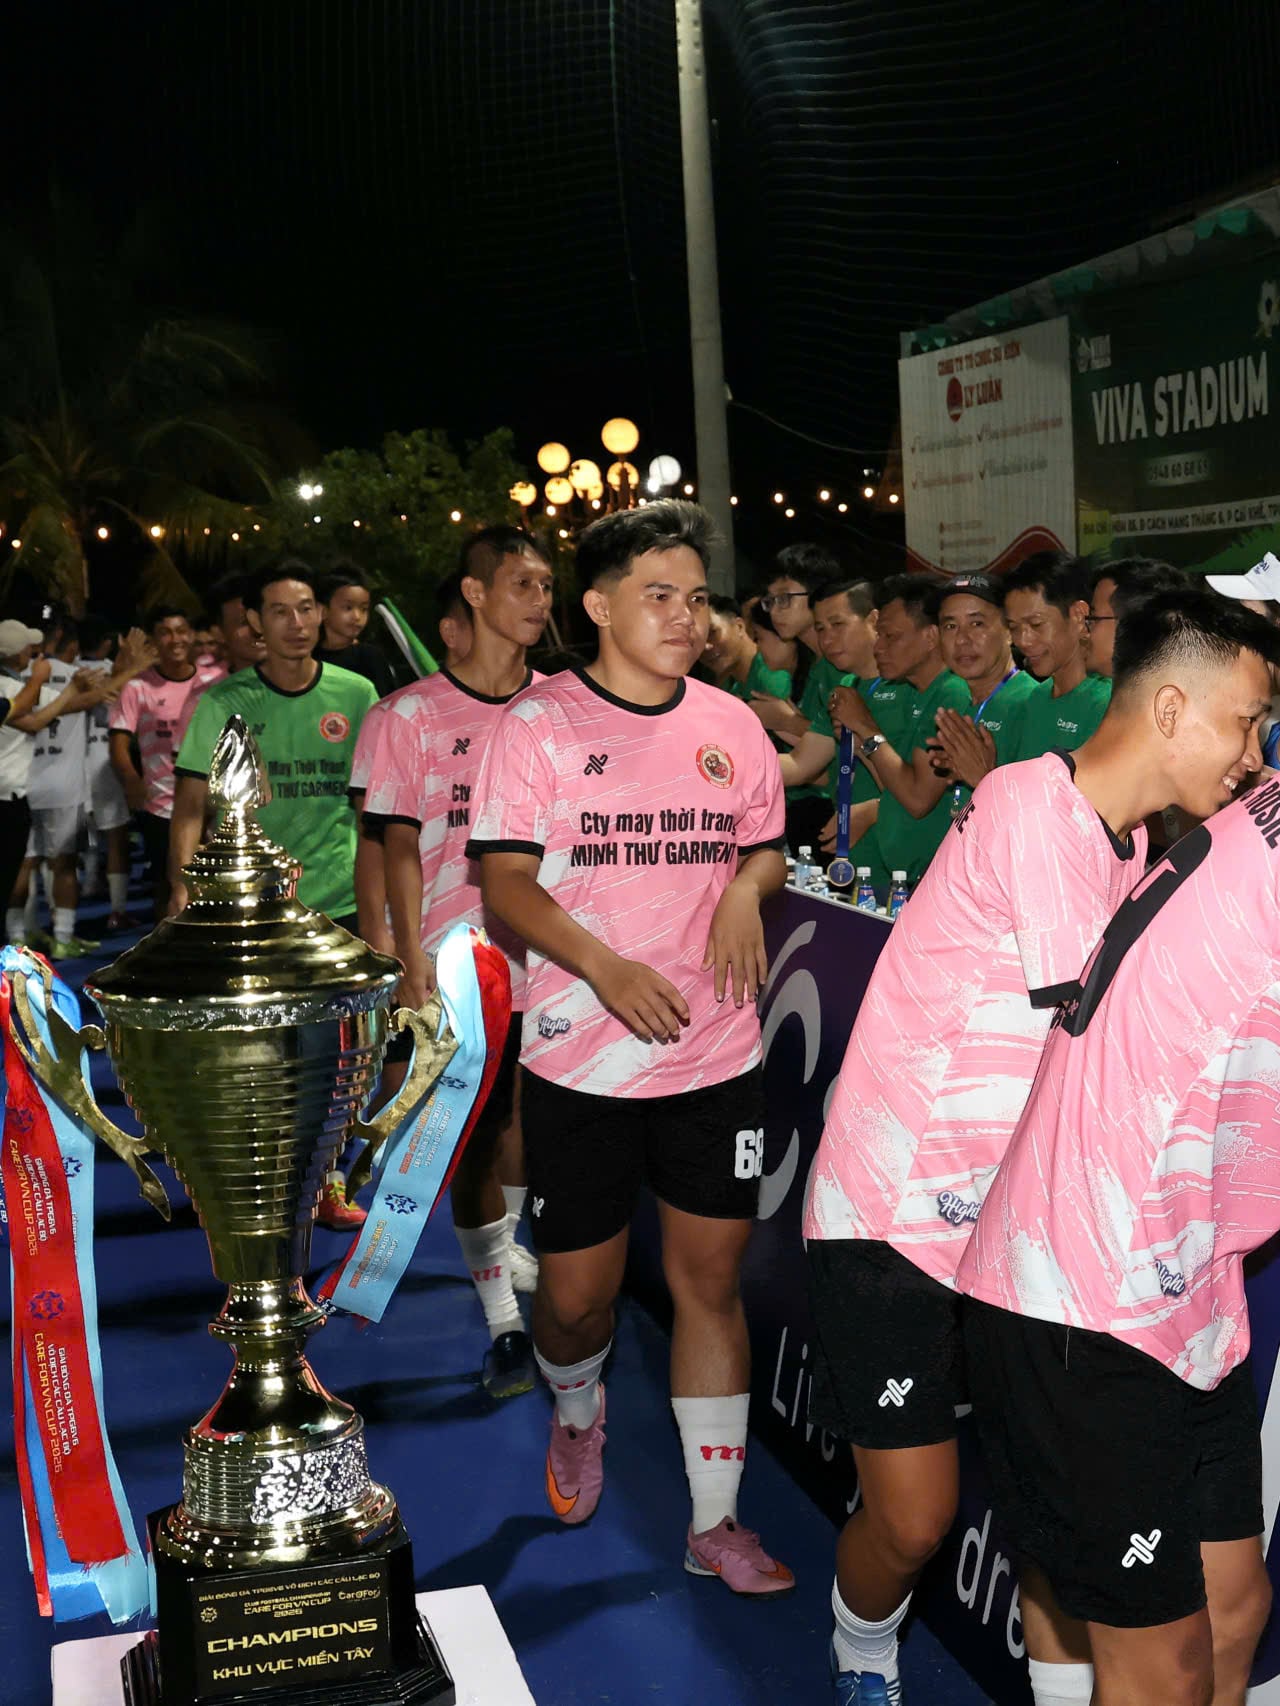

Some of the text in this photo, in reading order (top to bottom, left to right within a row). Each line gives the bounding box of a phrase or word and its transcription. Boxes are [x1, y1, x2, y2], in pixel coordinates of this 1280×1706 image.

[1092, 381, 1148, 445] VIVA
[1153, 351, 1269, 438] STADIUM
[302, 780, 346, 797] GARMEN
[452, 783, 470, 803] Cty
[448, 807, 469, 828] MIN
[581, 811, 610, 837] Cty
[616, 813, 653, 836] may
[659, 808, 695, 833] thời
[571, 842, 618, 867] MINH
[624, 840, 660, 865] THƯ
[538, 1014, 570, 1039] Hight
[9, 1139, 21, 1164] CARE
[735, 1128, 764, 1179] 68
[20, 1180, 31, 1199] VN
[22, 1199, 34, 1225] CUP
[938, 1191, 981, 1226] Hight
[34, 1332, 46, 1362] CARE
[39, 1363, 49, 1387] FOR
[42, 1388, 52, 1409] VN
[45, 1409, 58, 1436] CUP
[244, 1597, 332, 1616] CARE FOR VN CUP
[207, 1618, 378, 1655] CHAMPIONS
[213, 1646, 375, 1681] KHU VỰC MIỀN TÂY
